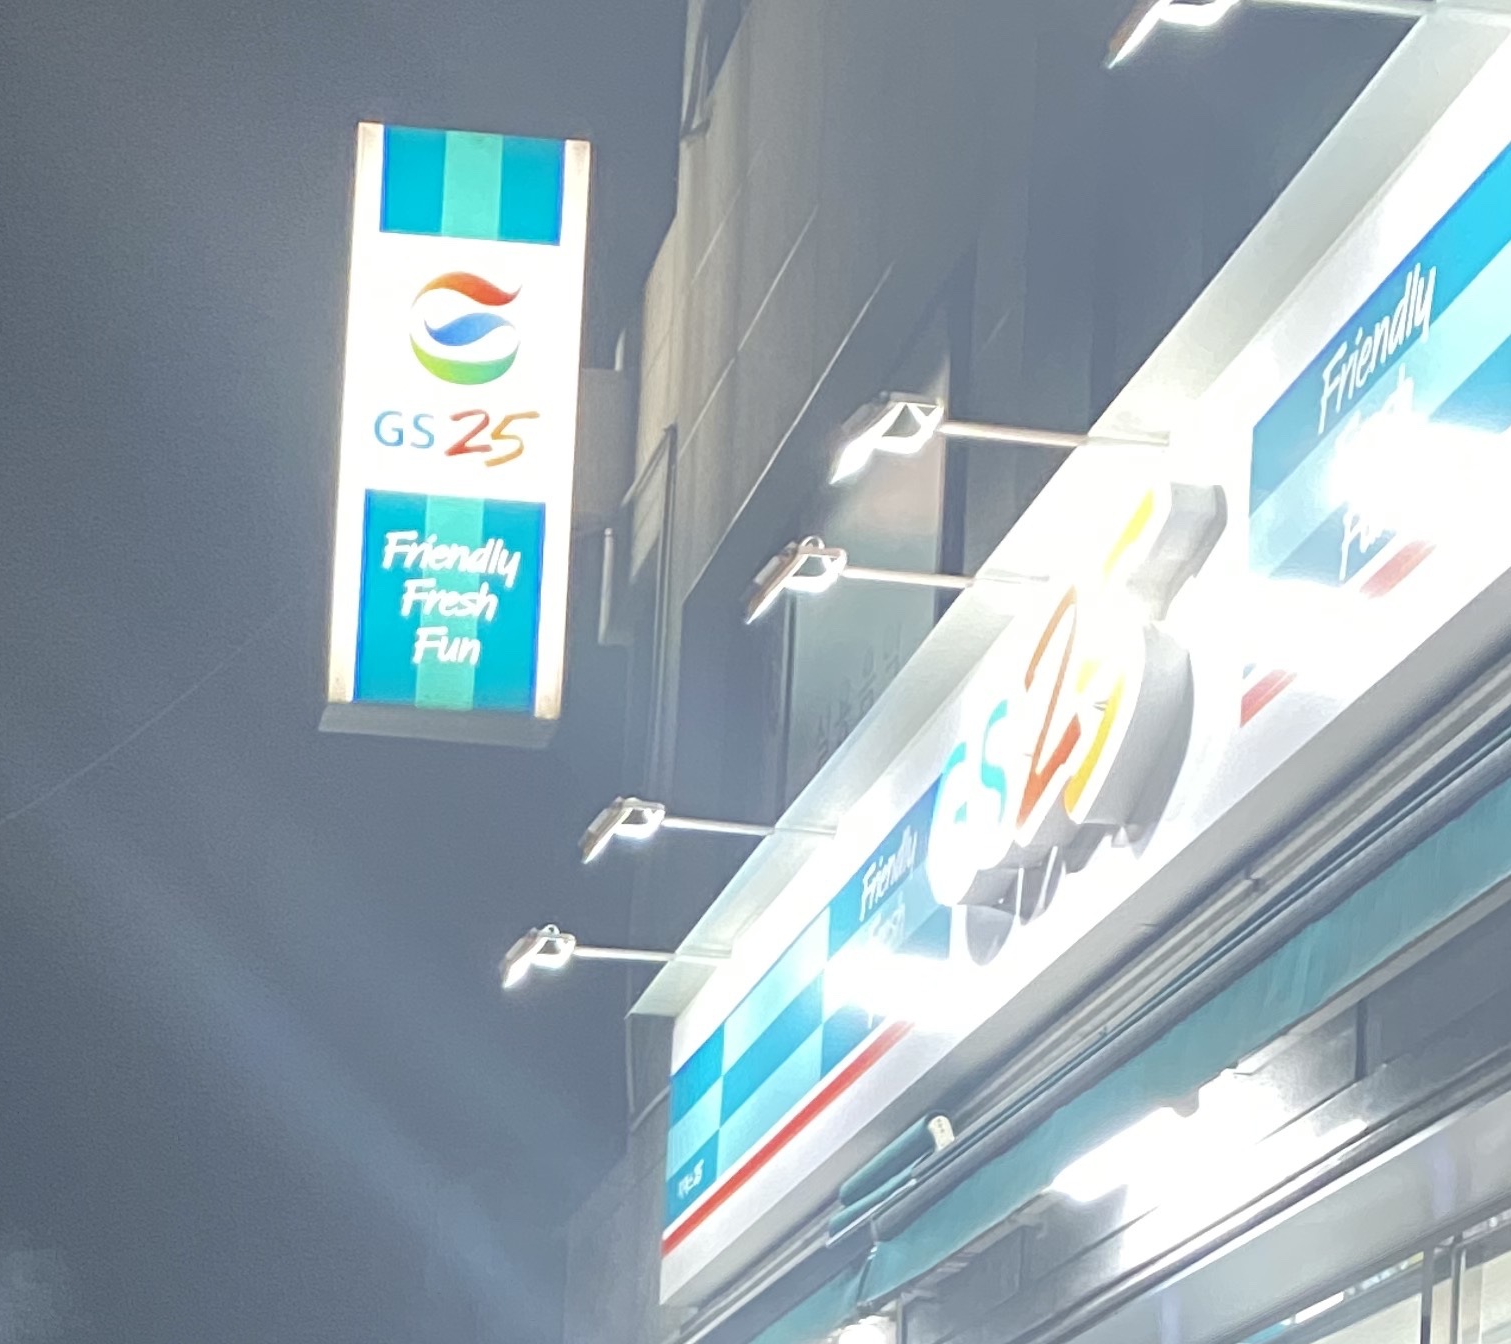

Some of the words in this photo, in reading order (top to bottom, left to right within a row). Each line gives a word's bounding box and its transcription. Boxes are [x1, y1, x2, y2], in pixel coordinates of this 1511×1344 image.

[1317, 262, 1436, 436] Friendly
[373, 408, 541, 467] GS25
[382, 530, 522, 588] Friendly
[400, 577, 499, 624] Fresh
[413, 626, 481, 665] Fun
[858, 824, 919, 922] Friendly
